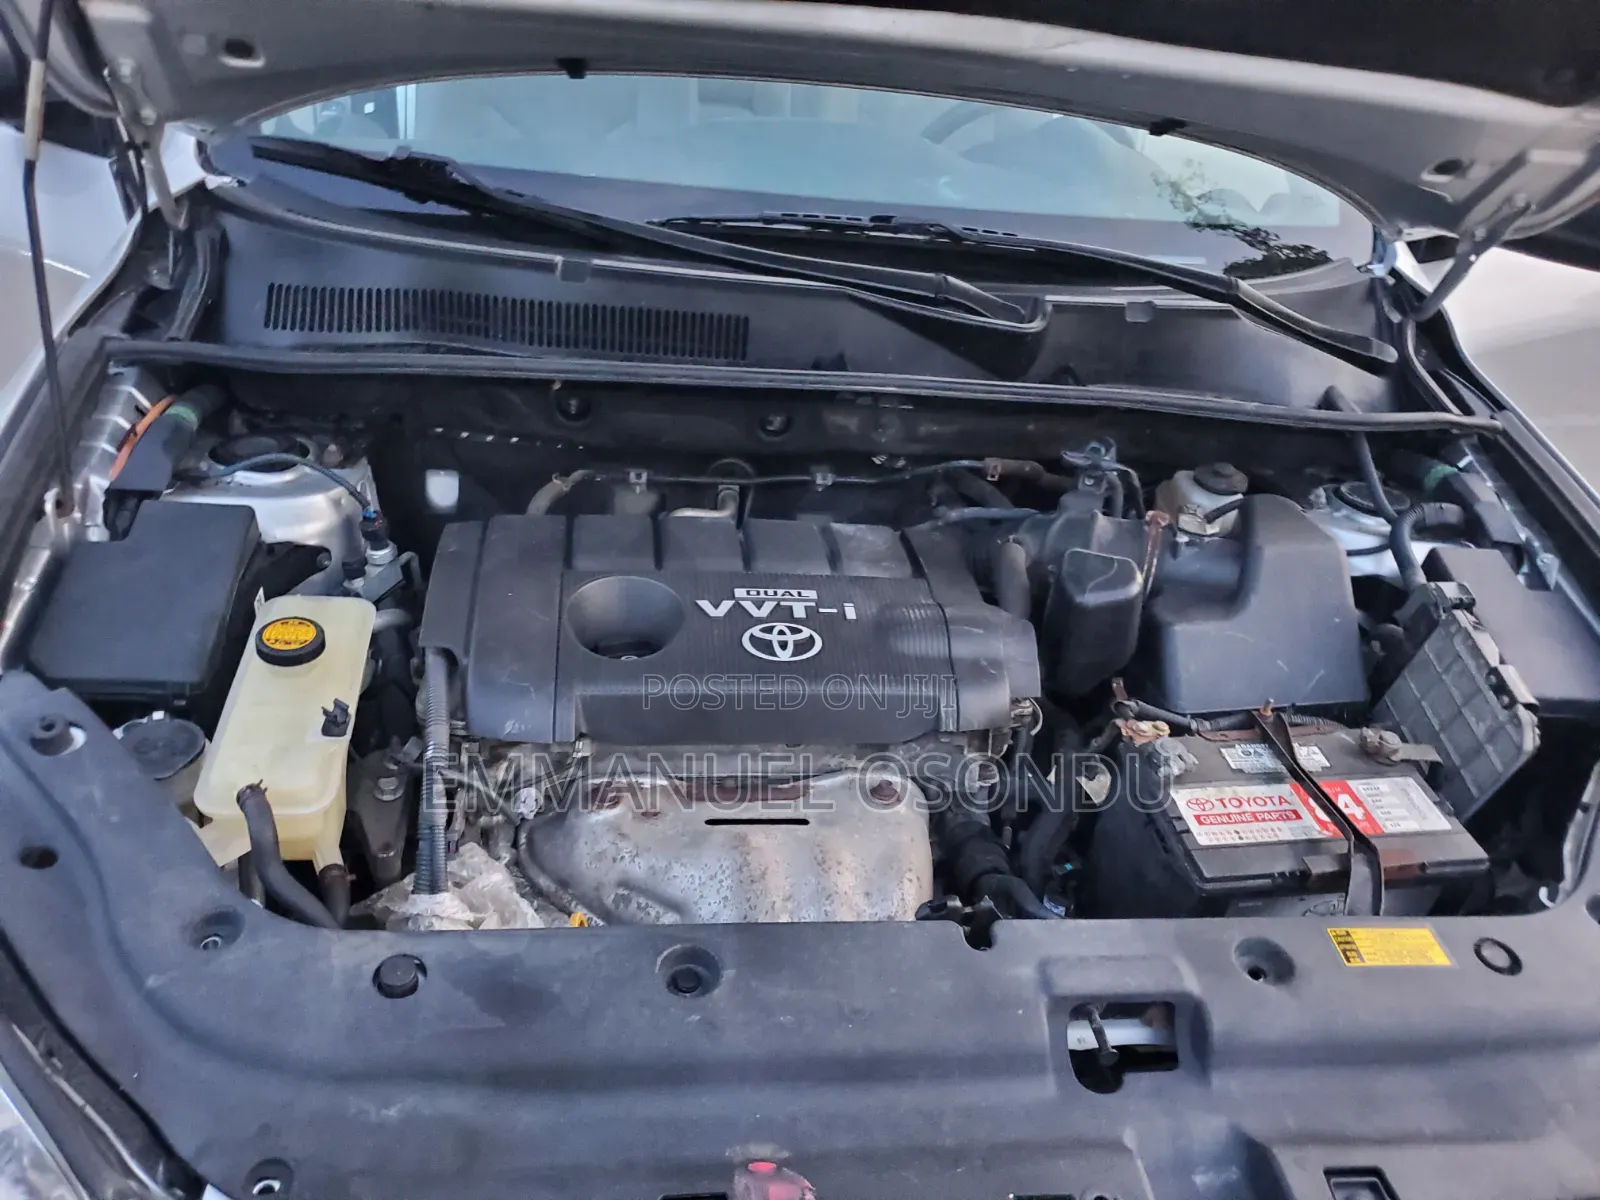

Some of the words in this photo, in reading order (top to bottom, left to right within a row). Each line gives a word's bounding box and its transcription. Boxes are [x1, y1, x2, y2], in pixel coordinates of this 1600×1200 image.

[745, 589, 811, 598] DUAL
[695, 599, 857, 620] VVT-i
[1215, 795, 1292, 809] TOYOTA
[1200, 811, 1255, 825] GENUINE
[1256, 810, 1297, 822] PARTS
